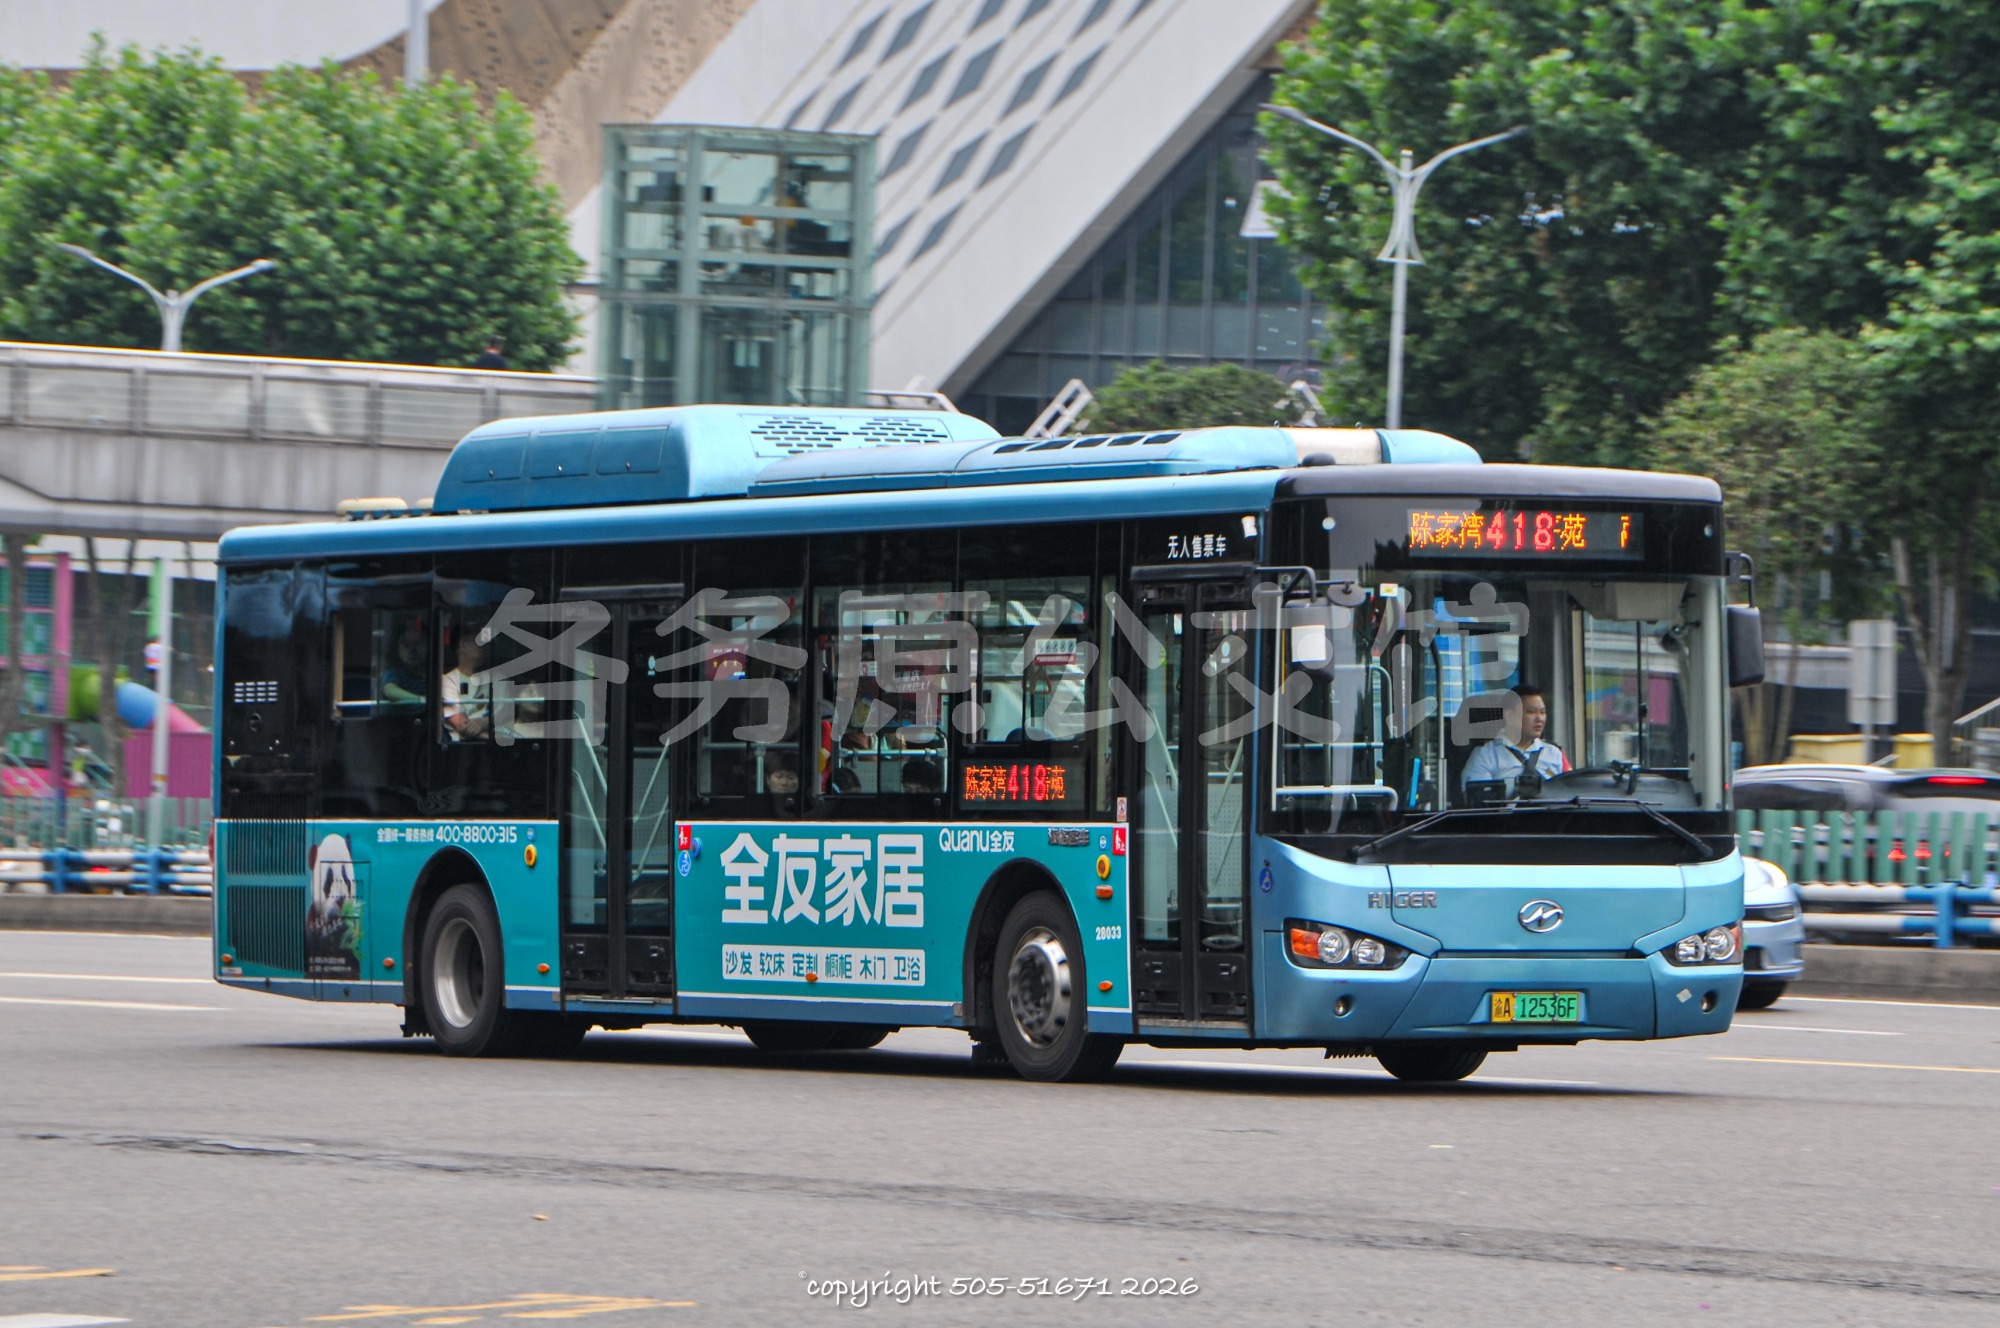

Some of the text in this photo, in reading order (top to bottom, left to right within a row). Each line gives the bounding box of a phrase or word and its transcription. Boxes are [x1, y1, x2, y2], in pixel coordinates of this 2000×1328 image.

[1167, 533, 1227, 559] 无人售票车
[720, 832, 924, 928] 全友家居
[1368, 891, 1438, 909] HIGER
[1095, 925, 1121, 941] 28033
[725, 950, 921, 981] 沙发 软床 定制 橱柜 木门 卫浴
